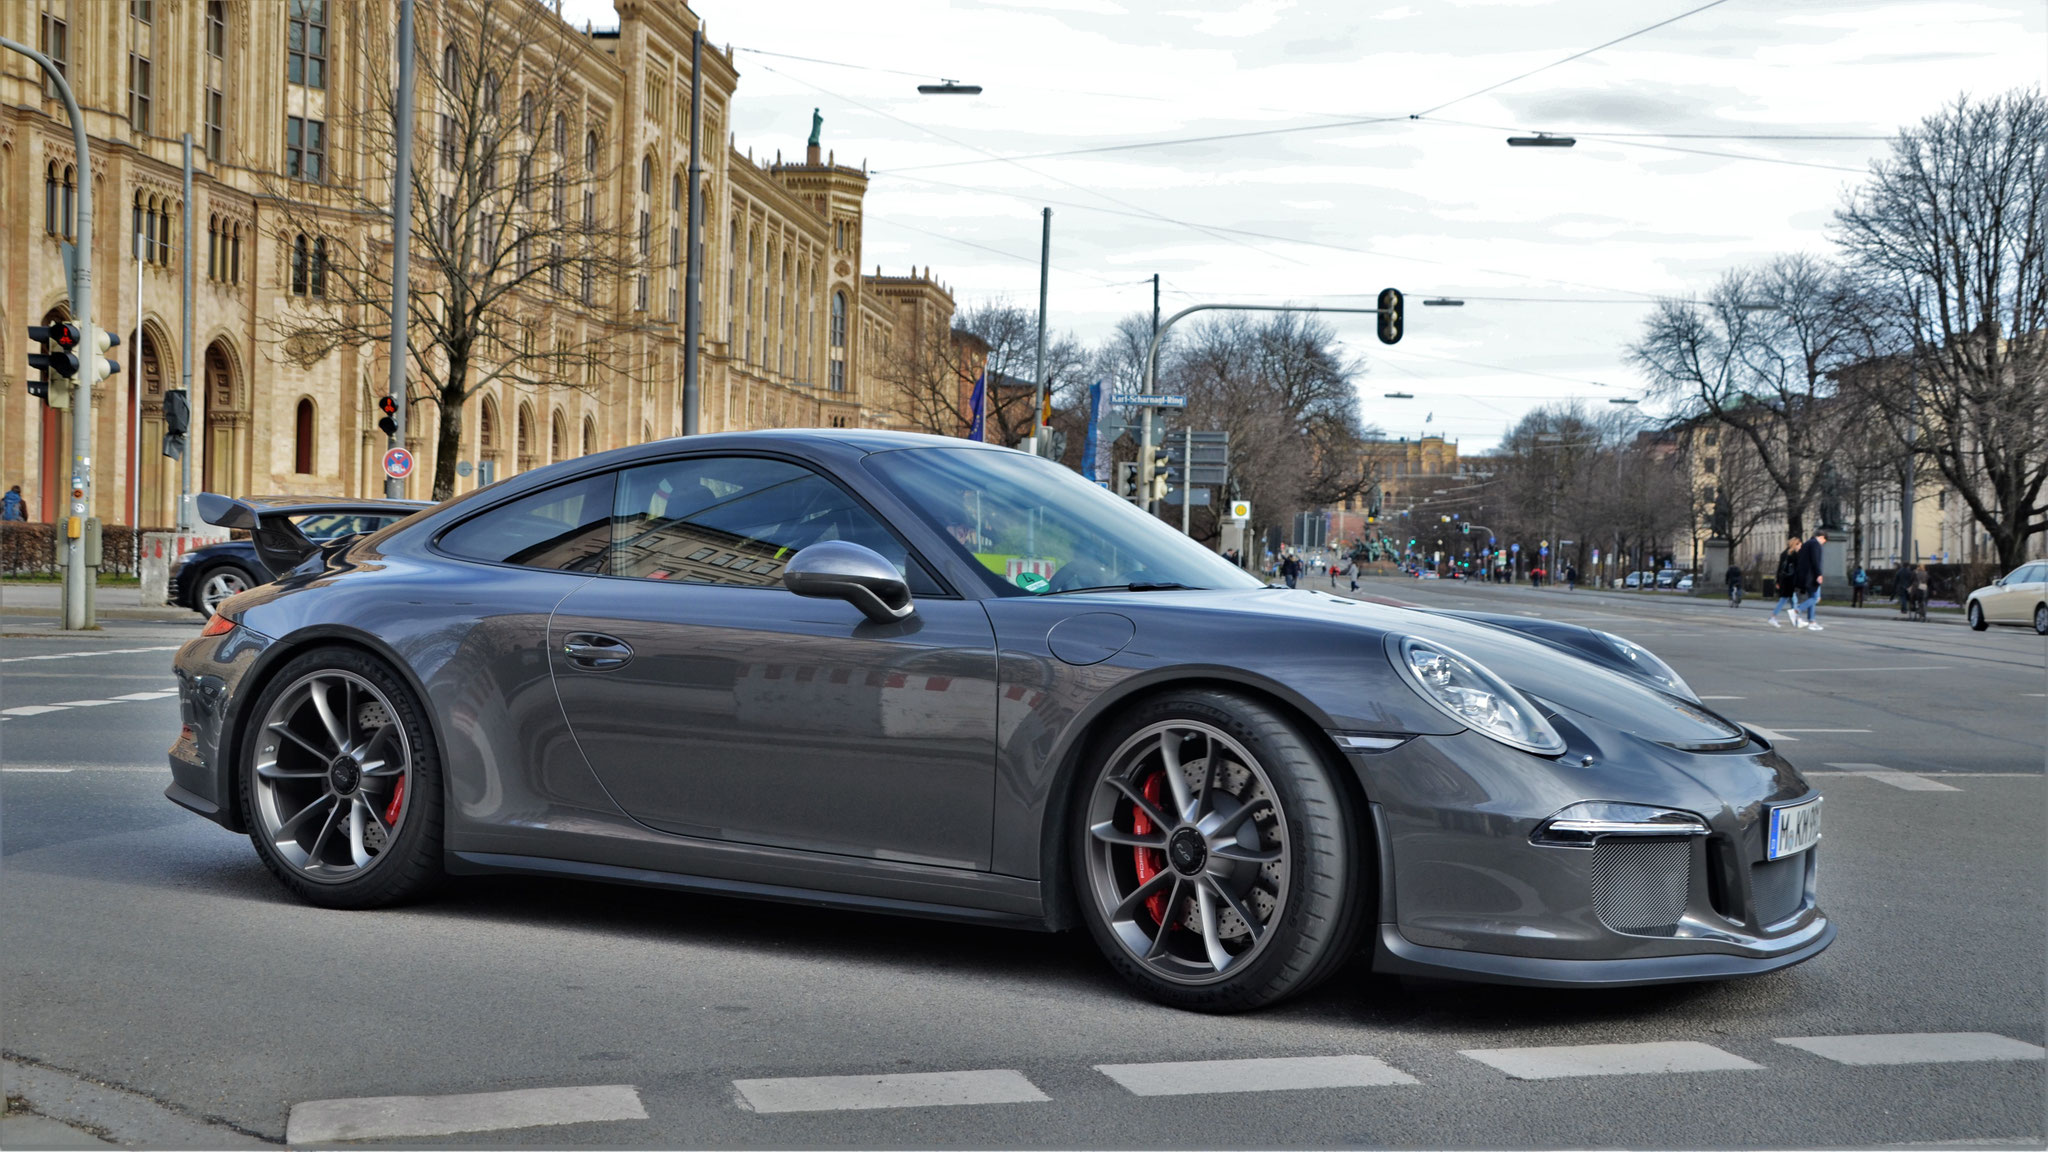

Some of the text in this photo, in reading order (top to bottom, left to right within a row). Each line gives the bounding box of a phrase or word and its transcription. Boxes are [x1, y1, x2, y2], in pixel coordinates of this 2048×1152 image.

[1111, 394, 1184, 406] Karl-Scharnagl-Ring
[383, 678, 424, 752] MICHELIN
[1779, 813, 1791, 852] M
